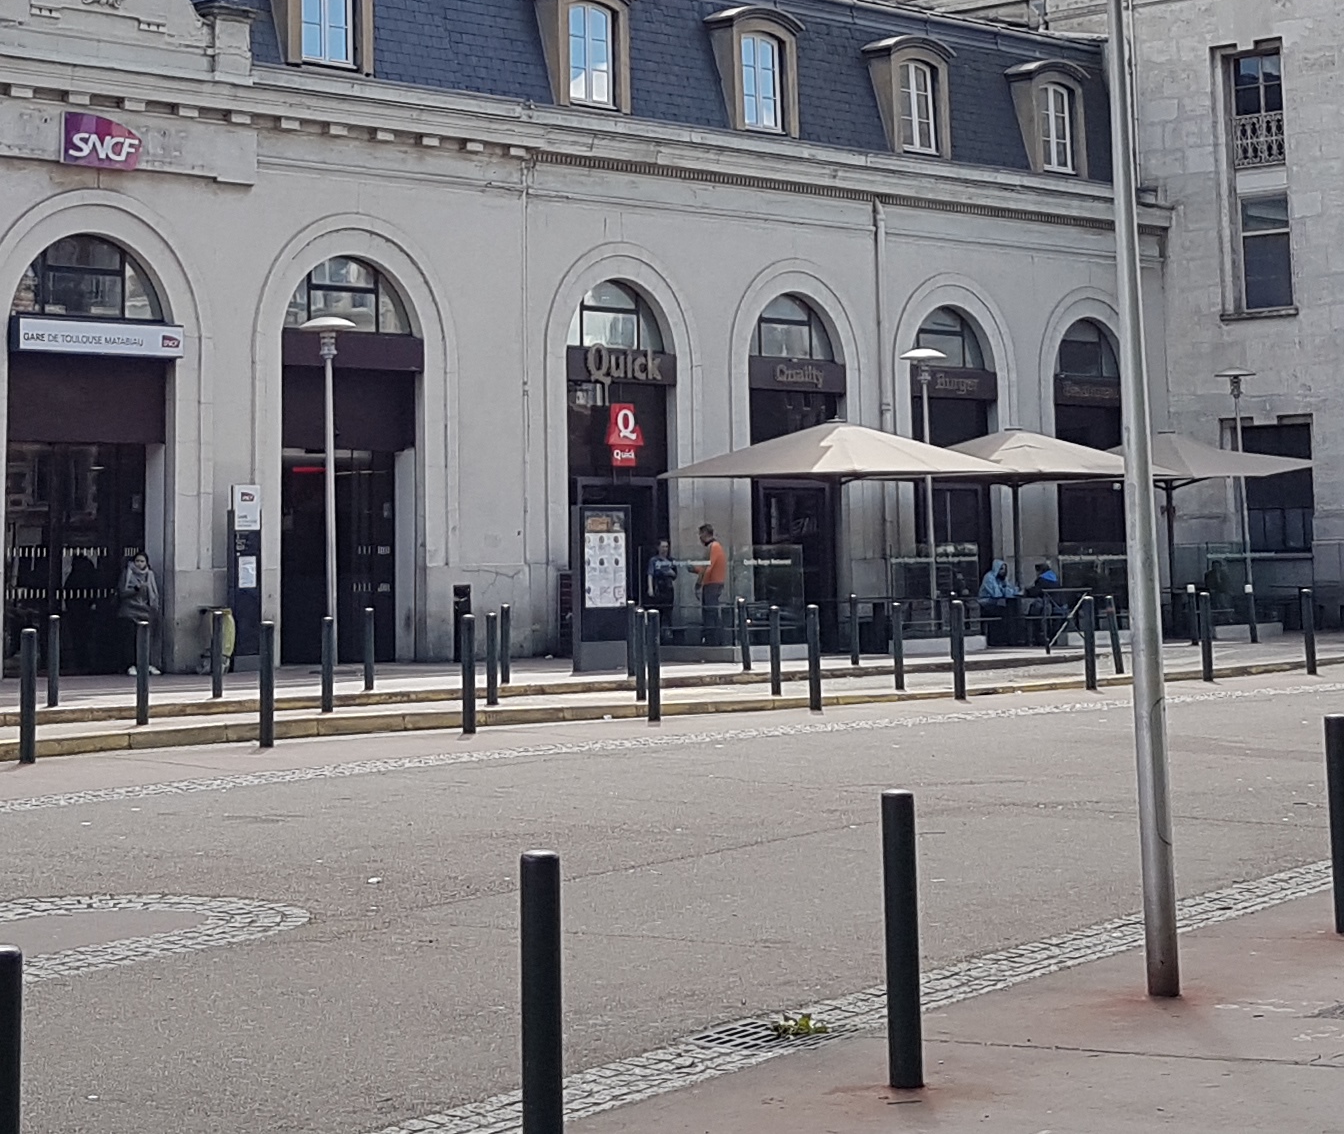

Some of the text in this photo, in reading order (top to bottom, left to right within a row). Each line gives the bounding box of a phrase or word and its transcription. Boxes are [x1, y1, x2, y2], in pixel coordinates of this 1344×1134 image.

[68, 132, 140, 161] SNCF
[22, 332, 144, 347] GARE DE TOULOUSE MATABIAU
[586, 343, 662, 386] Quick
[776, 364, 823, 388] Quality
[935, 372, 980, 394] Burger
[617, 409, 637, 440] Q
[613, 449, 635, 460] Quick
